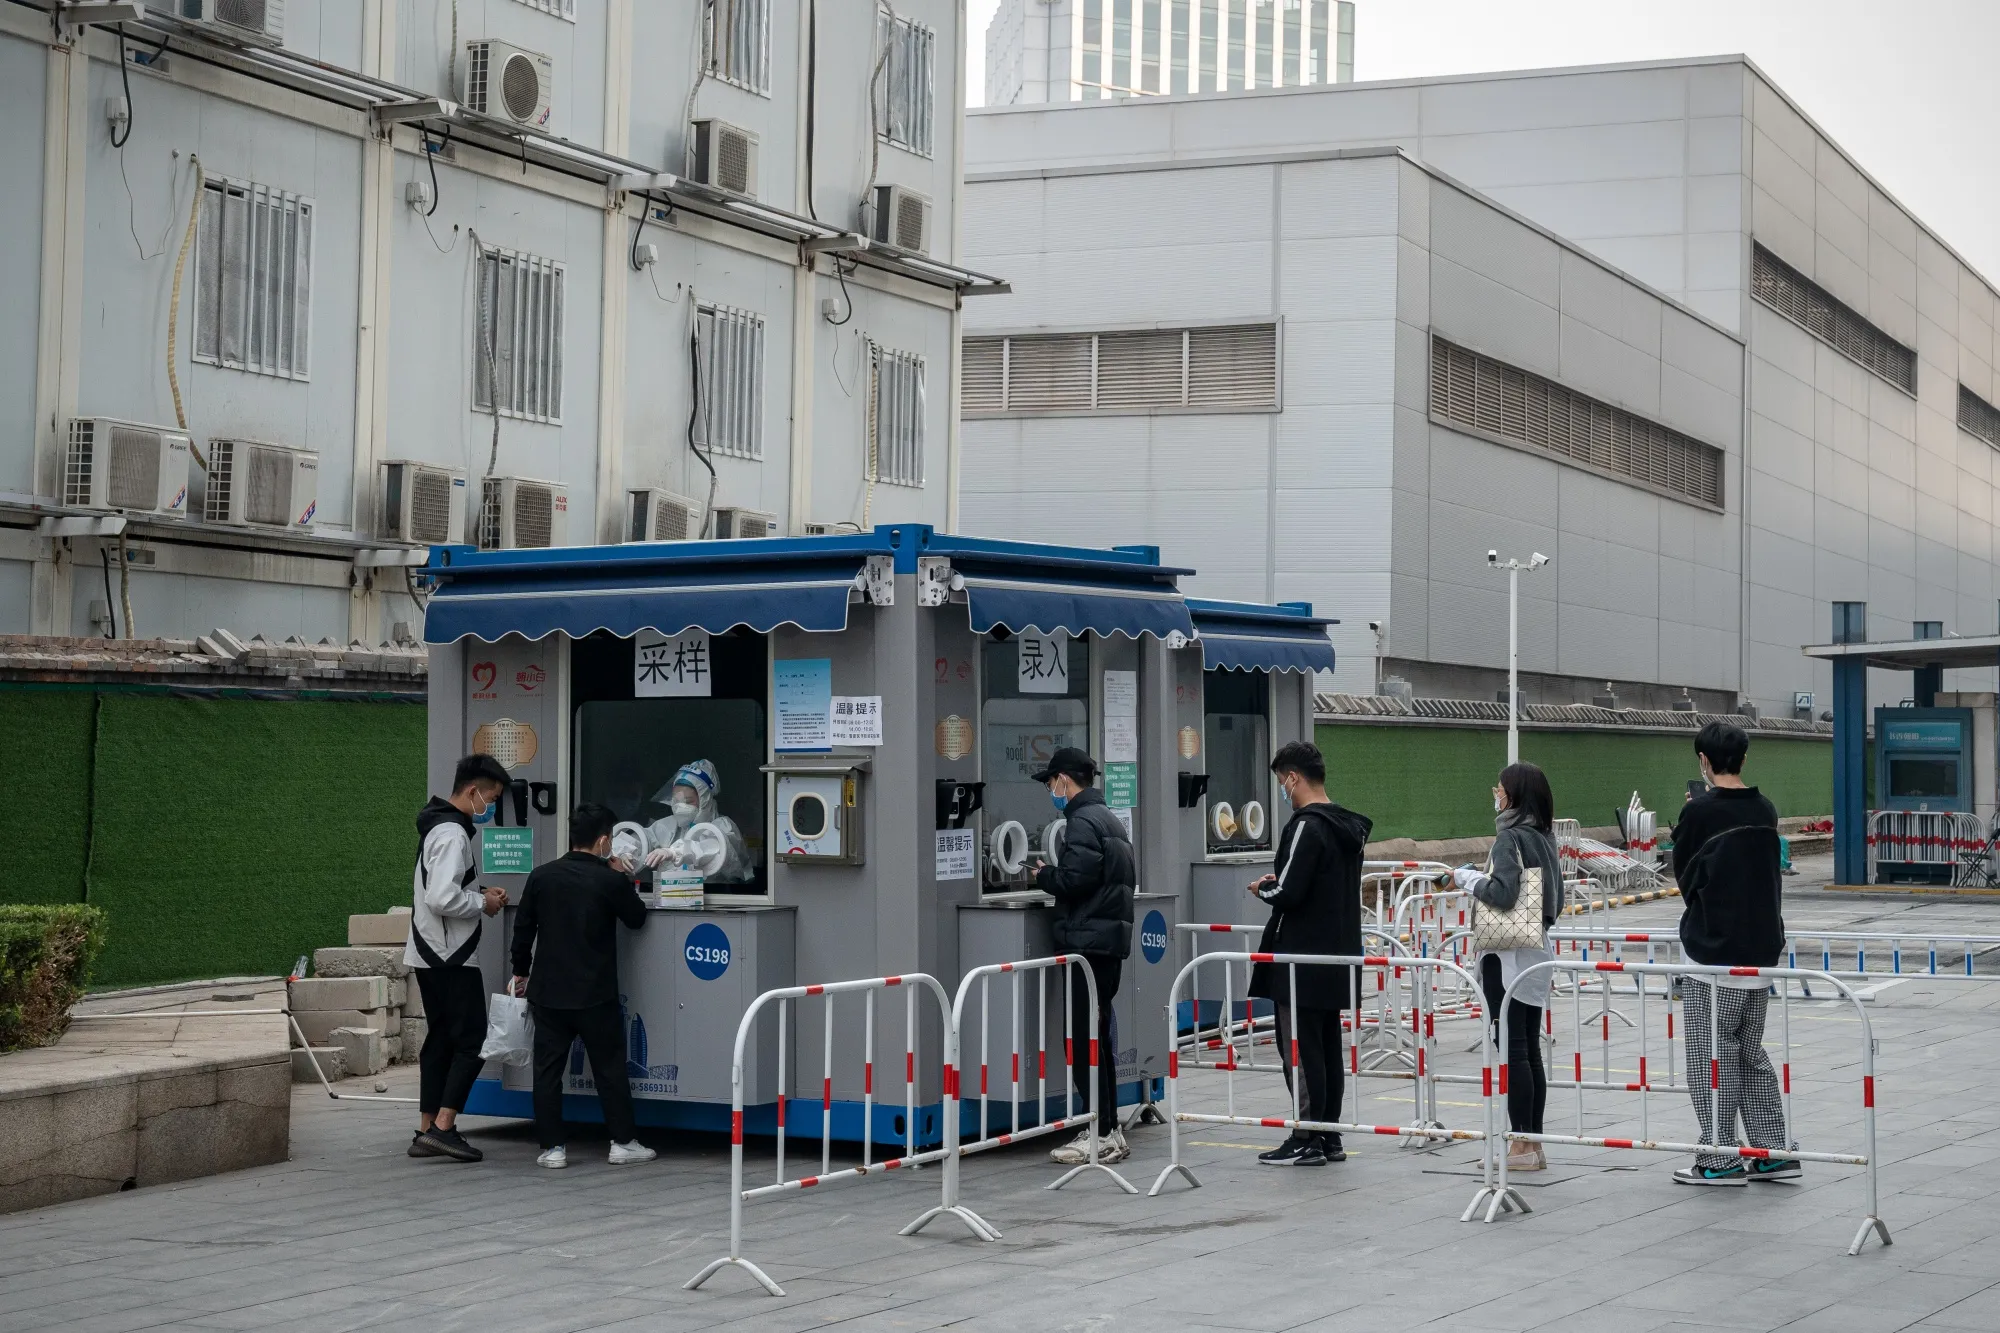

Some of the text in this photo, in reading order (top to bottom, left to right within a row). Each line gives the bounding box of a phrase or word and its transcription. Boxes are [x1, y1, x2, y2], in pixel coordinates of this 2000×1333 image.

[638, 640, 707, 684] 采样
[1021, 639, 1066, 680] 录入
[836, 702, 877, 715] 温馨提示
[936, 835, 972, 852] 温馨提示
[1141, 932, 1167, 948] CS198
[686, 945, 729, 964] CS198
[569, 1077, 597, 1089] 设备维
